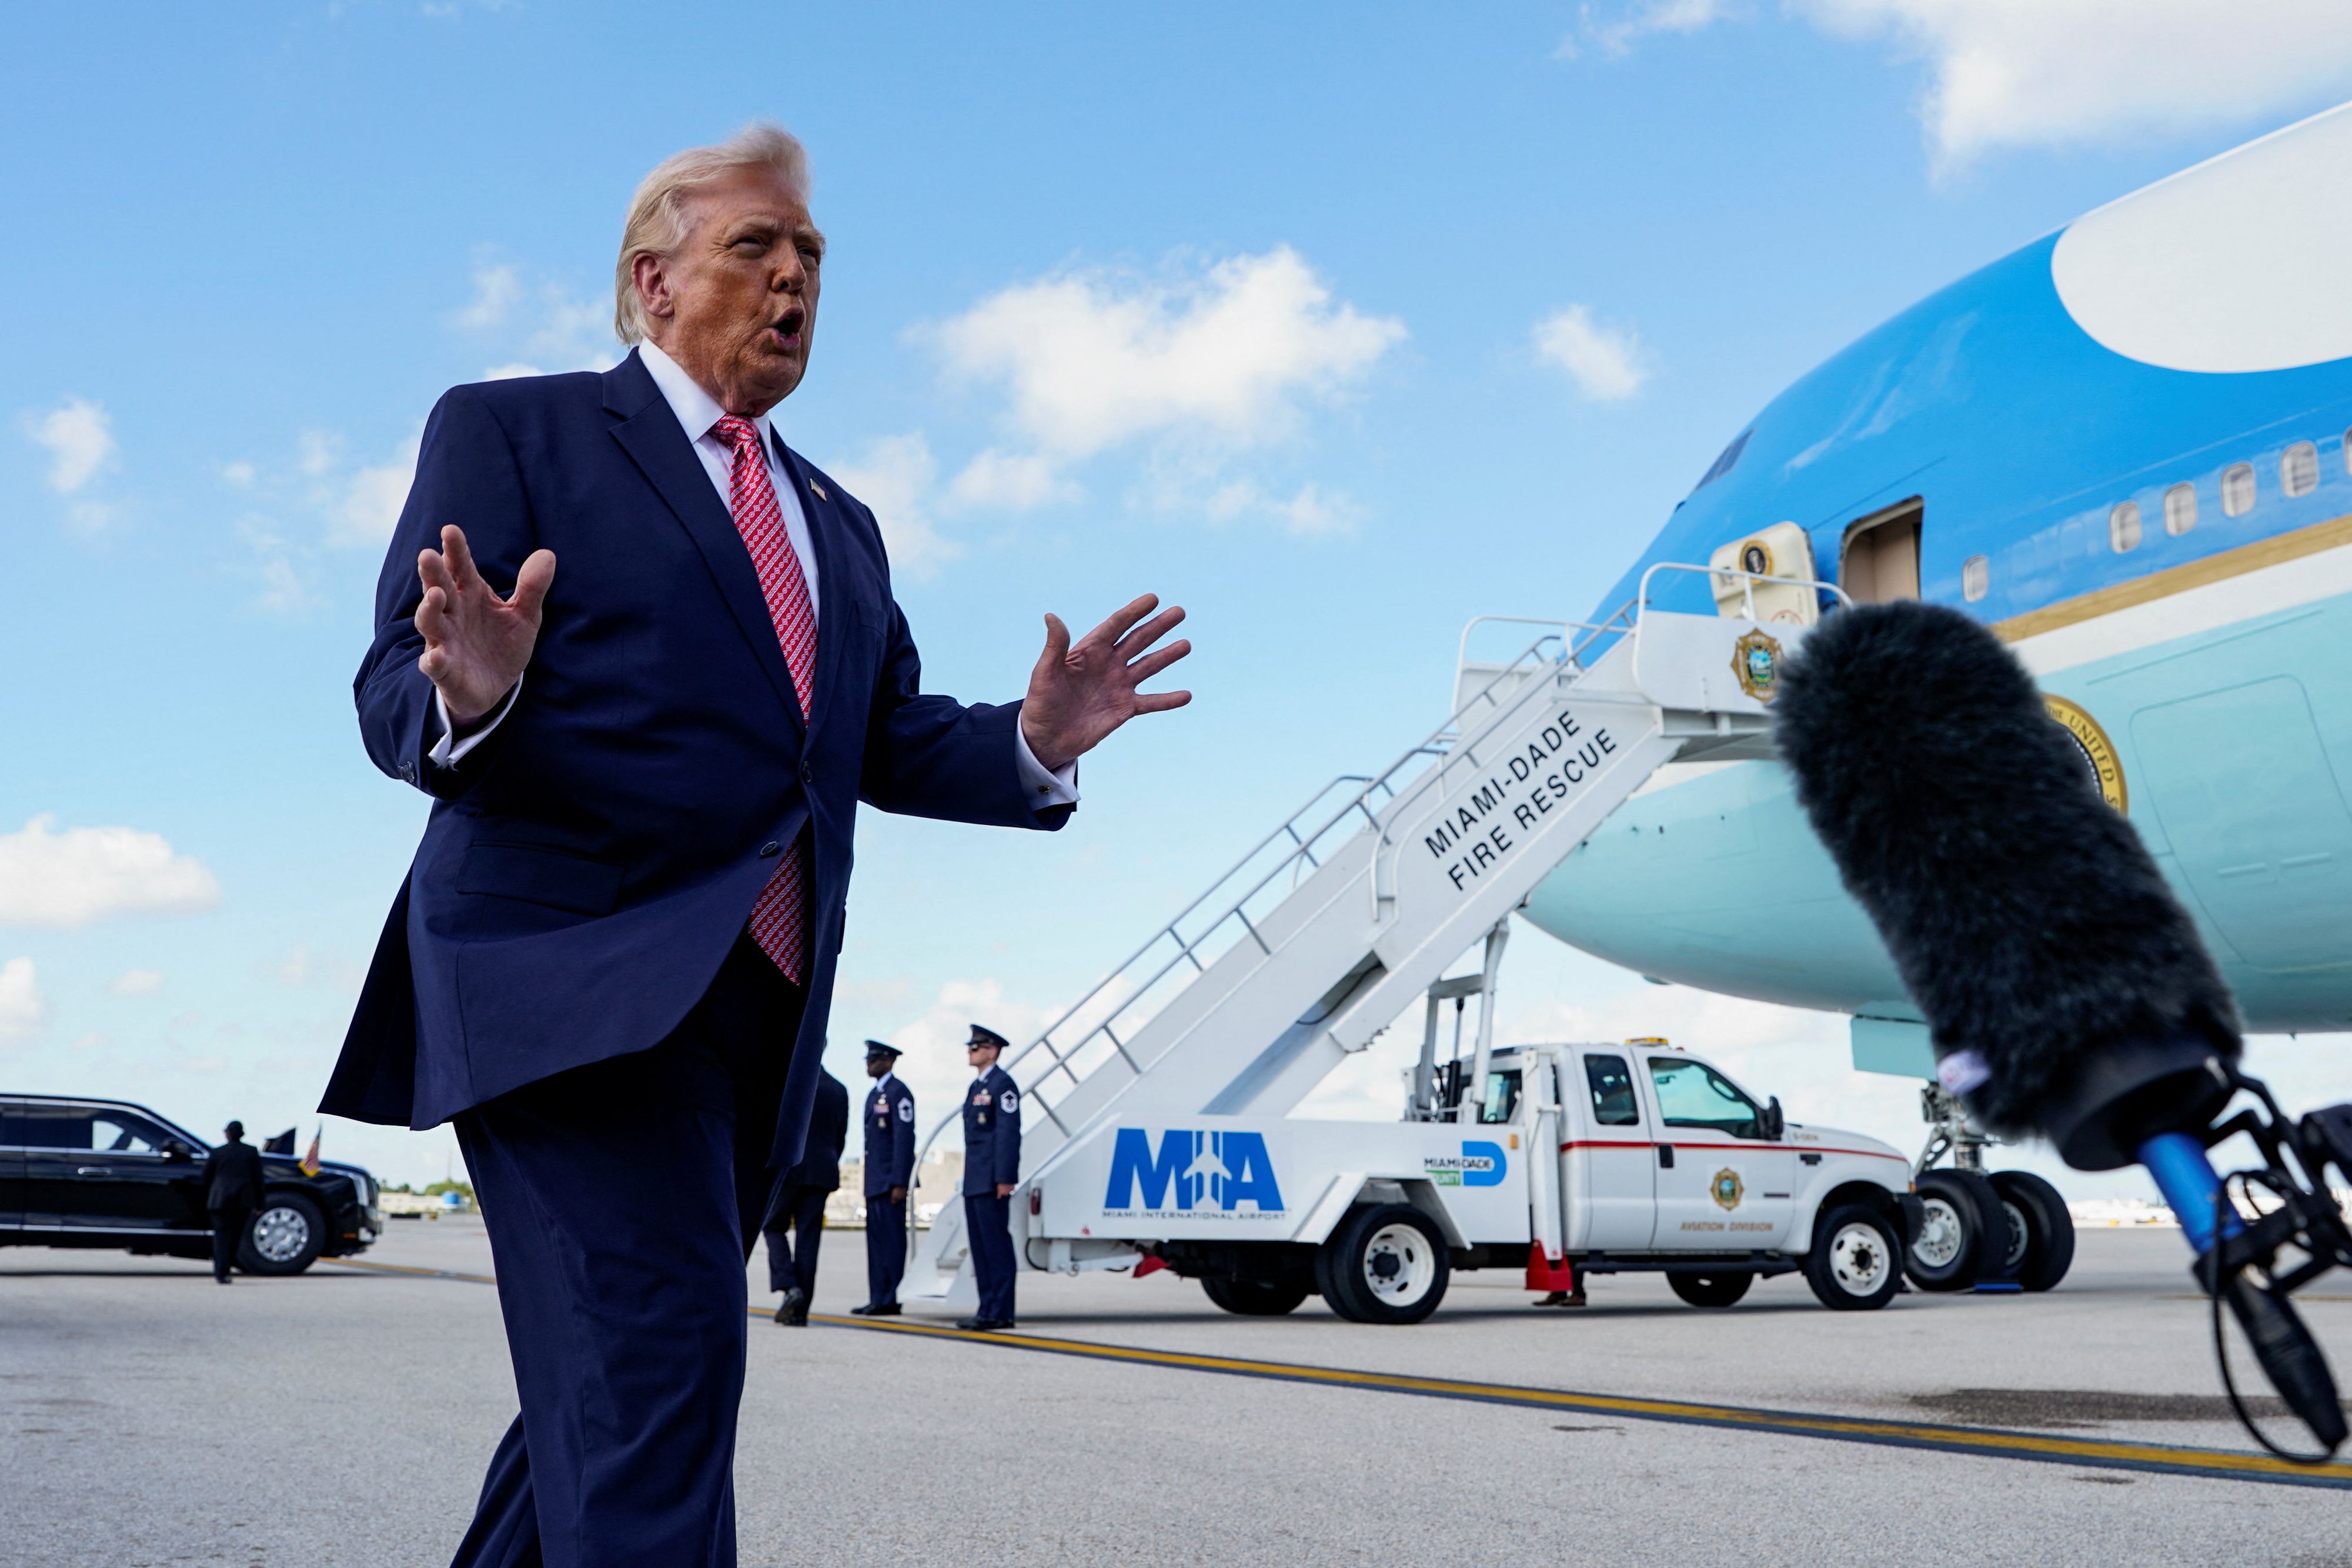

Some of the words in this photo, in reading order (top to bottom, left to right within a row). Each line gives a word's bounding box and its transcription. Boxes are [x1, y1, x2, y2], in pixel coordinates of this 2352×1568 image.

[1425, 710, 1581, 858] MIAMI-DADE
[2069, 714, 2116, 783] UNITED
[1448, 825, 1512, 891] FIRE
[1514, 728, 1617, 830] RESCUE
[1105, 1128, 1285, 1211] MIA
[1141, 1211, 1234, 1221] INTERNATIONAL
[1237, 1213, 1287, 1221] AIRPORT
[1680, 1221, 1725, 1232] AVIATION
[1729, 1221, 1774, 1232] DIVISION
